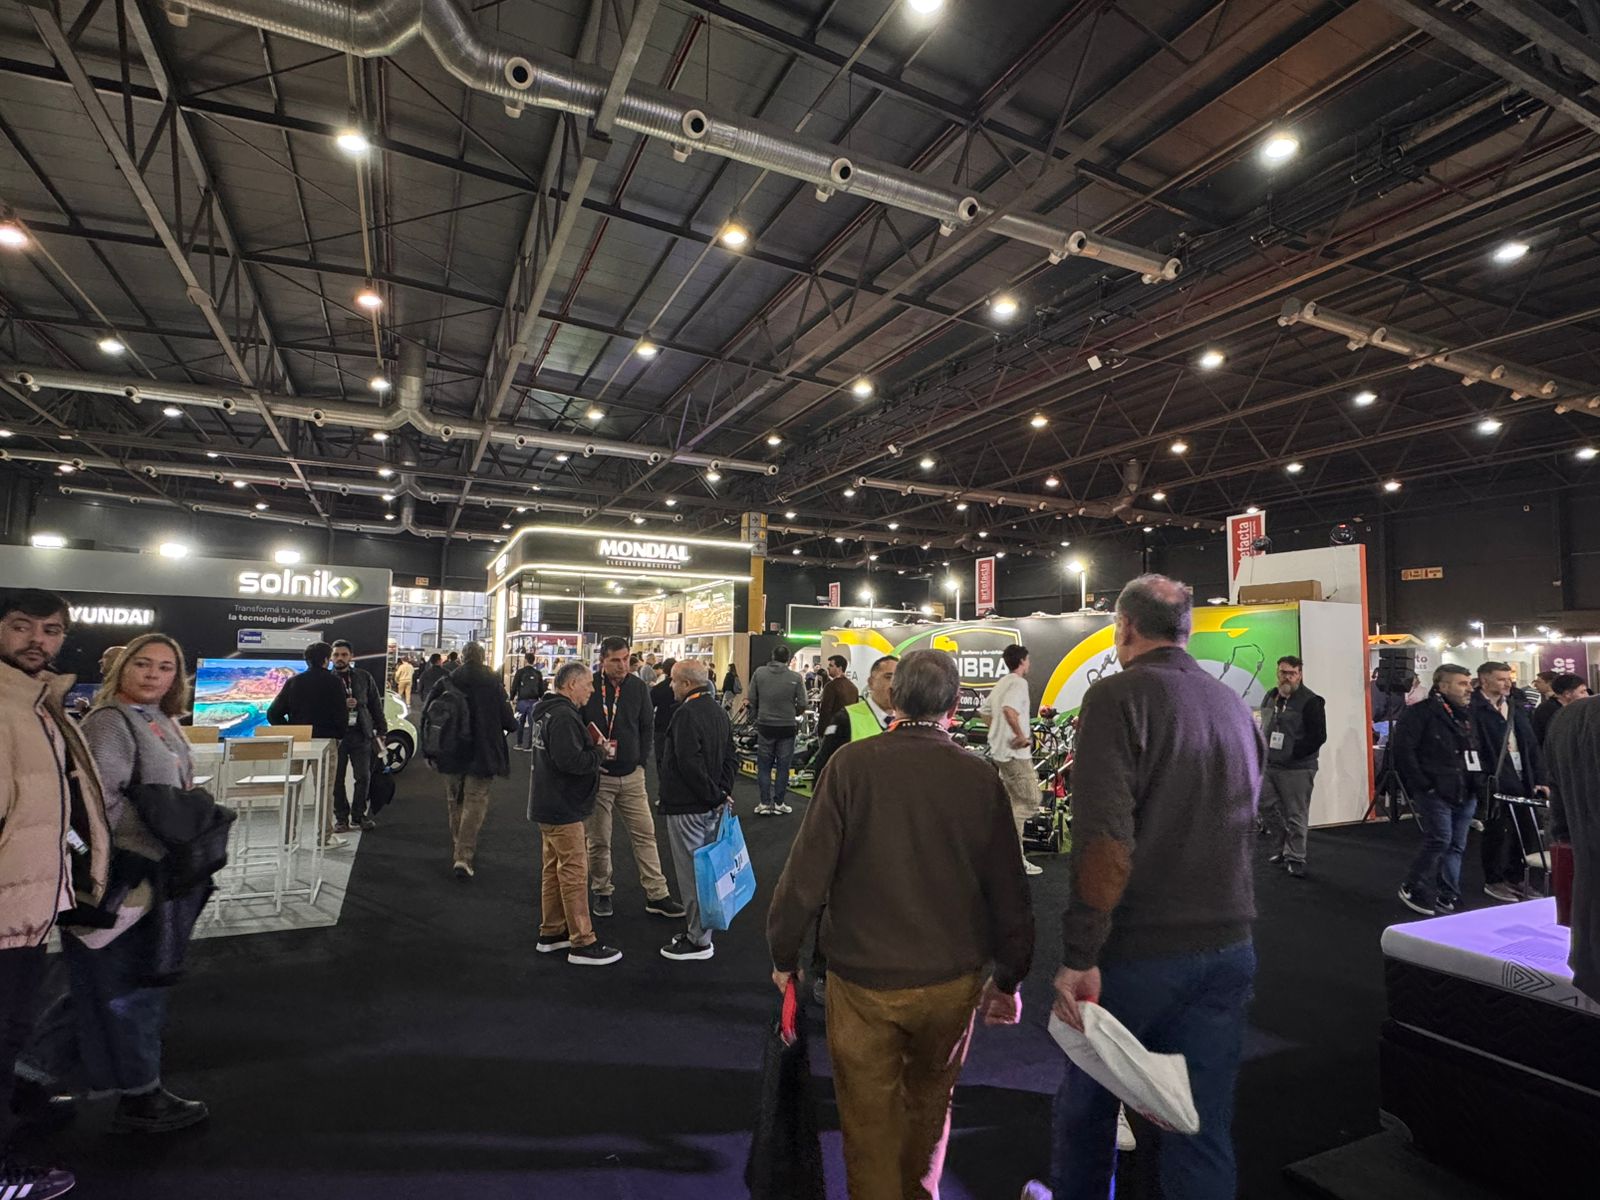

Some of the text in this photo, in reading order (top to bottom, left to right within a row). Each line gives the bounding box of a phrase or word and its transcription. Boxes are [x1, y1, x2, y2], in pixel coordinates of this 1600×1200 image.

[599, 539, 690, 560] MONDIAL
[1237, 521, 1250, 559] efacta
[238, 568, 342, 598] solnik
[68, 606, 155, 625] YUNDAI
[228, 613, 335, 625] la tecnología inteligente
[234, 604, 280, 614] Transformá
[281, 606, 290, 614] tu
[291, 606, 315, 616] hogar
[953, 657, 1010, 678] IBRA
